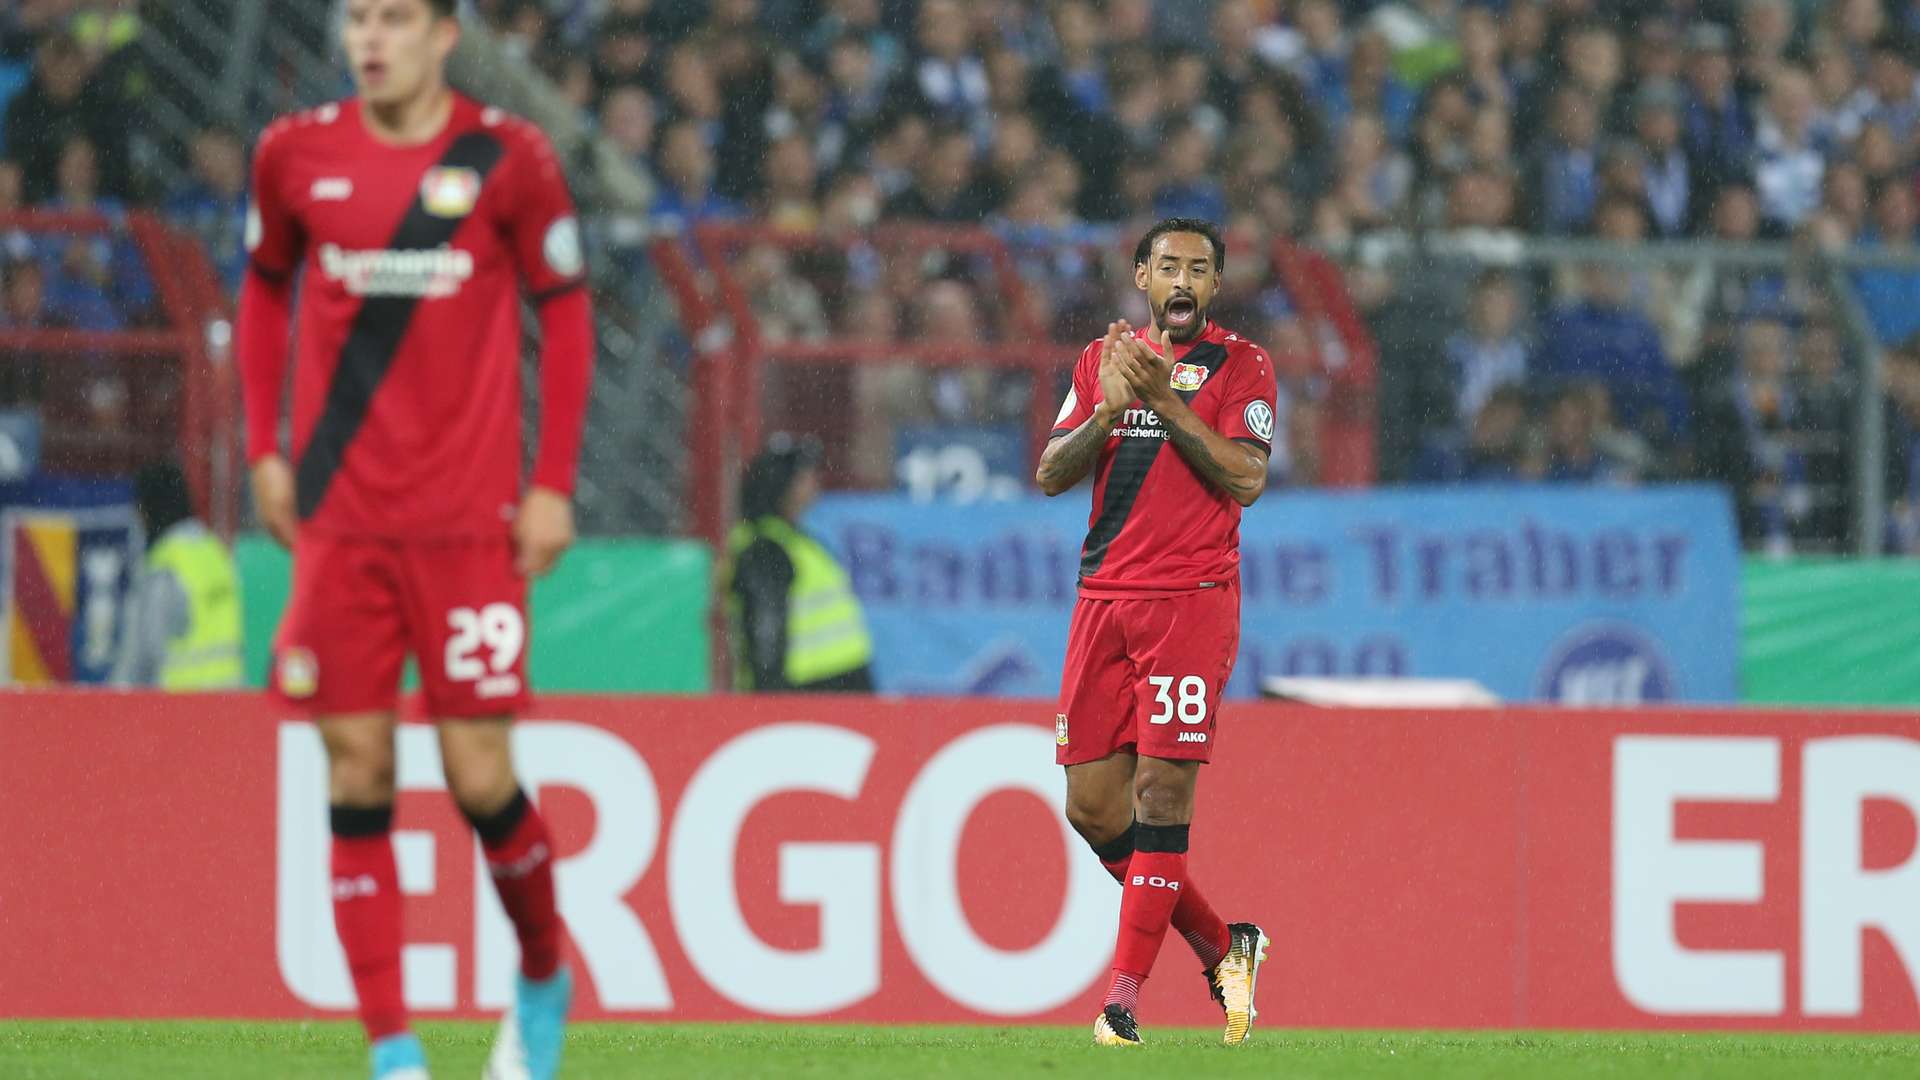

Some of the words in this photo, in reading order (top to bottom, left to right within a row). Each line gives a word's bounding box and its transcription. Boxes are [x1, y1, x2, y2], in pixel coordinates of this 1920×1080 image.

[1110, 426, 1171, 441] ersicherung
[444, 602, 523, 682] 29
[1149, 675, 1207, 725] 38
[1177, 732, 1207, 743] JAKO
[277, 720, 1119, 1018] ERGO
